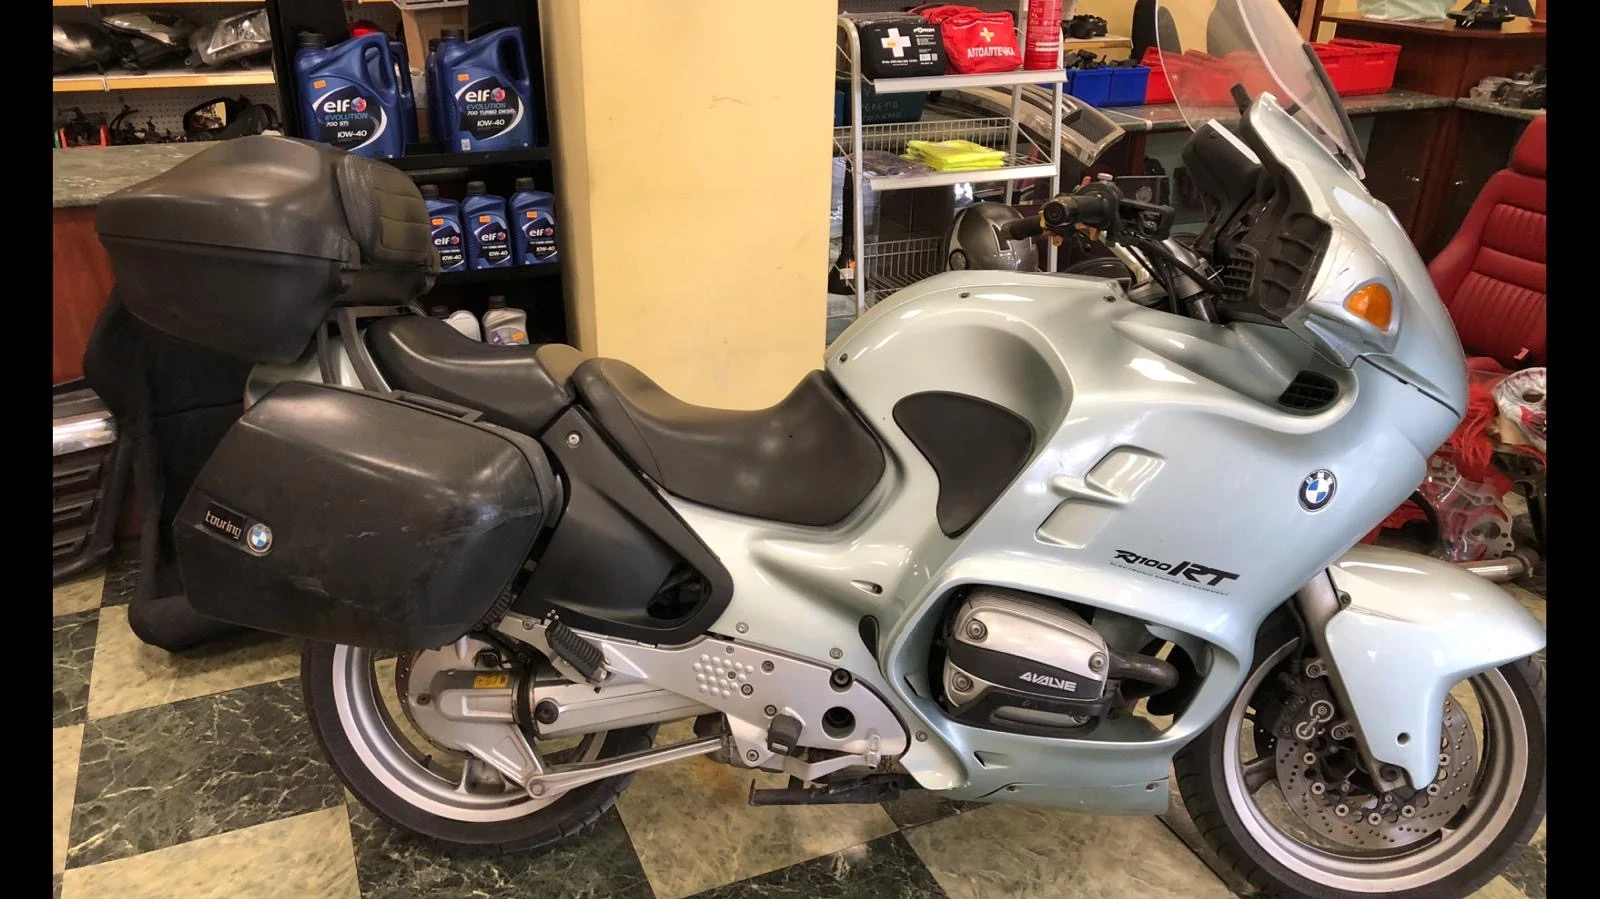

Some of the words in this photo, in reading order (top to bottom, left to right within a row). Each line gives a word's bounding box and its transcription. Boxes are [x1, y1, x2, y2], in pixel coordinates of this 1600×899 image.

[967, 45, 1016, 58] АВТОАПТЕЧКА
[465, 89, 490, 102] elf
[323, 99, 350, 113] elf
[466, 103, 506, 111] EVOLUTION
[325, 113, 368, 121] EVOLUTION
[337, 130, 368, 138] 10W-40
[529, 228, 544, 236] elf
[434, 236, 450, 246] elf
[481, 233, 497, 241] elf
[205, 510, 242, 540] touring
